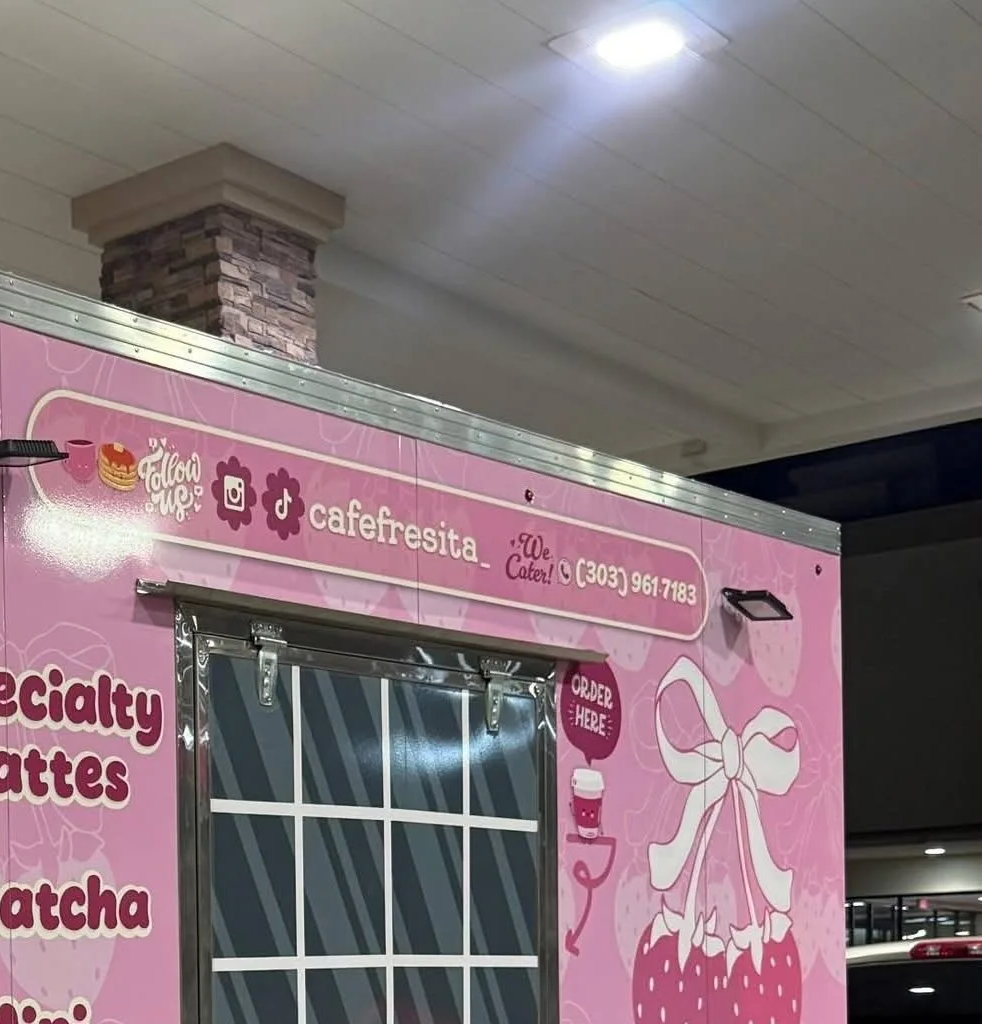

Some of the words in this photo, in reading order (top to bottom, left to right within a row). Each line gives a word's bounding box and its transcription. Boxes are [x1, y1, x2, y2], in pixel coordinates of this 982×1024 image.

[138, 446, 201, 493] Follow
[309, 499, 490, 568] cafefresita_
[519, 532, 550, 560] We
[505, 553, 554, 584] Cater!
[575, 557, 629, 597] (303)
[571, 674, 613, 709] ORDER
[575, 704, 606, 737] HERE
